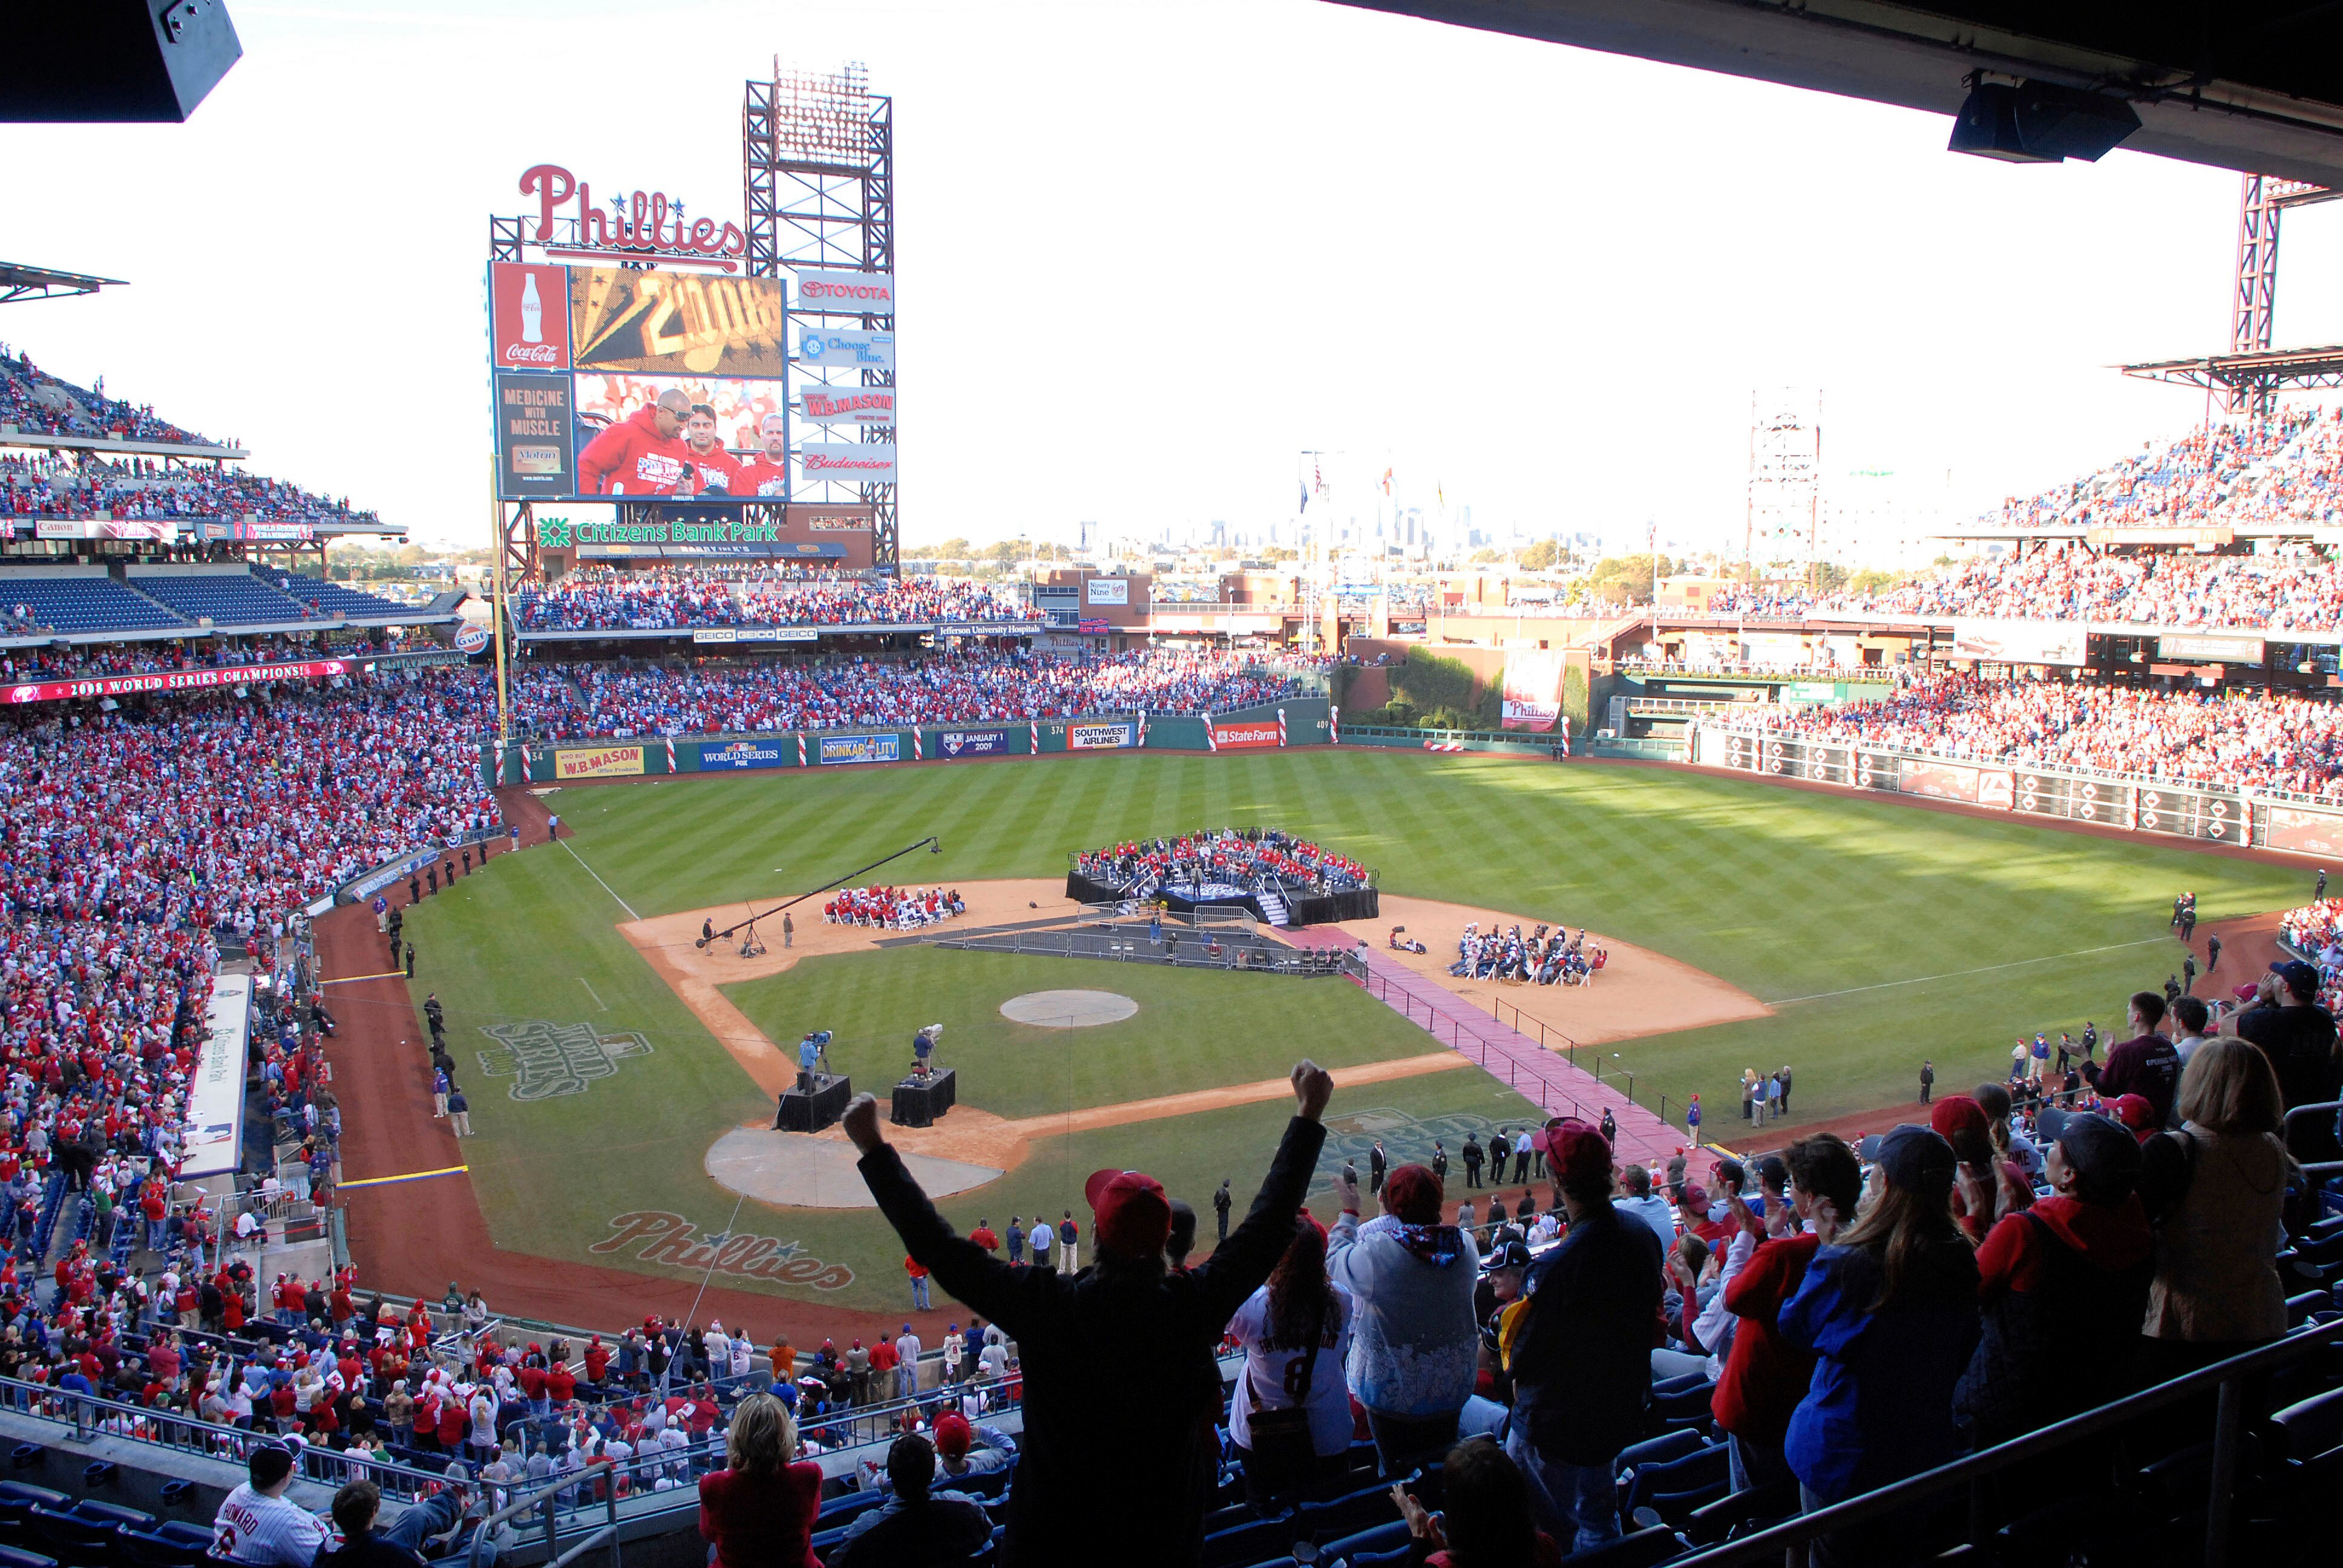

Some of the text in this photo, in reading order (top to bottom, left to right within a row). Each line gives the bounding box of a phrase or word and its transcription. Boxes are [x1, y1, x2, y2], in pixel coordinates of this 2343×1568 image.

[519, 164, 747, 255] Phillies
[824, 284, 890, 300] TOYOTA
[828, 338, 871, 350] Choose
[511, 419, 561, 436] MUSCLE
[519, 450, 556, 460] Motrin
[805, 454, 893, 470] Budweiser
[39, 523, 73, 532] Canon
[575, 520, 779, 543] Citizens Bank Park
[738, 630, 776, 639] GEICO
[940, 625, 1040, 635] Jefferson University Hospitals
[458, 632, 485, 645] Gulf
[1049, 636, 1080, 647] Phillies
[71, 665, 304, 696] 2008 WORLD SERIES CHAMPIONS!
[1510, 700, 1555, 718] Phillies
[1051, 726, 1064, 734] 374
[1316, 720, 1329, 729] 409
[1075, 727, 1127, 737] SOUTHWEST
[945, 734, 962, 743] MLB
[965, 734, 997, 743] JANUARY
[1083, 736, 1120, 745] AIRLINES
[704, 750, 779, 763] WORLD SERIES
[552, 1022, 614, 1078] WORLD
[479, 1021, 588, 1102] SERIES
[588, 1210, 856, 1292] Phillies
[733, 1351, 739, 1360] 6
[952, 1345, 958, 1354] 8
[223, 1503, 259, 1536] HOWARD
